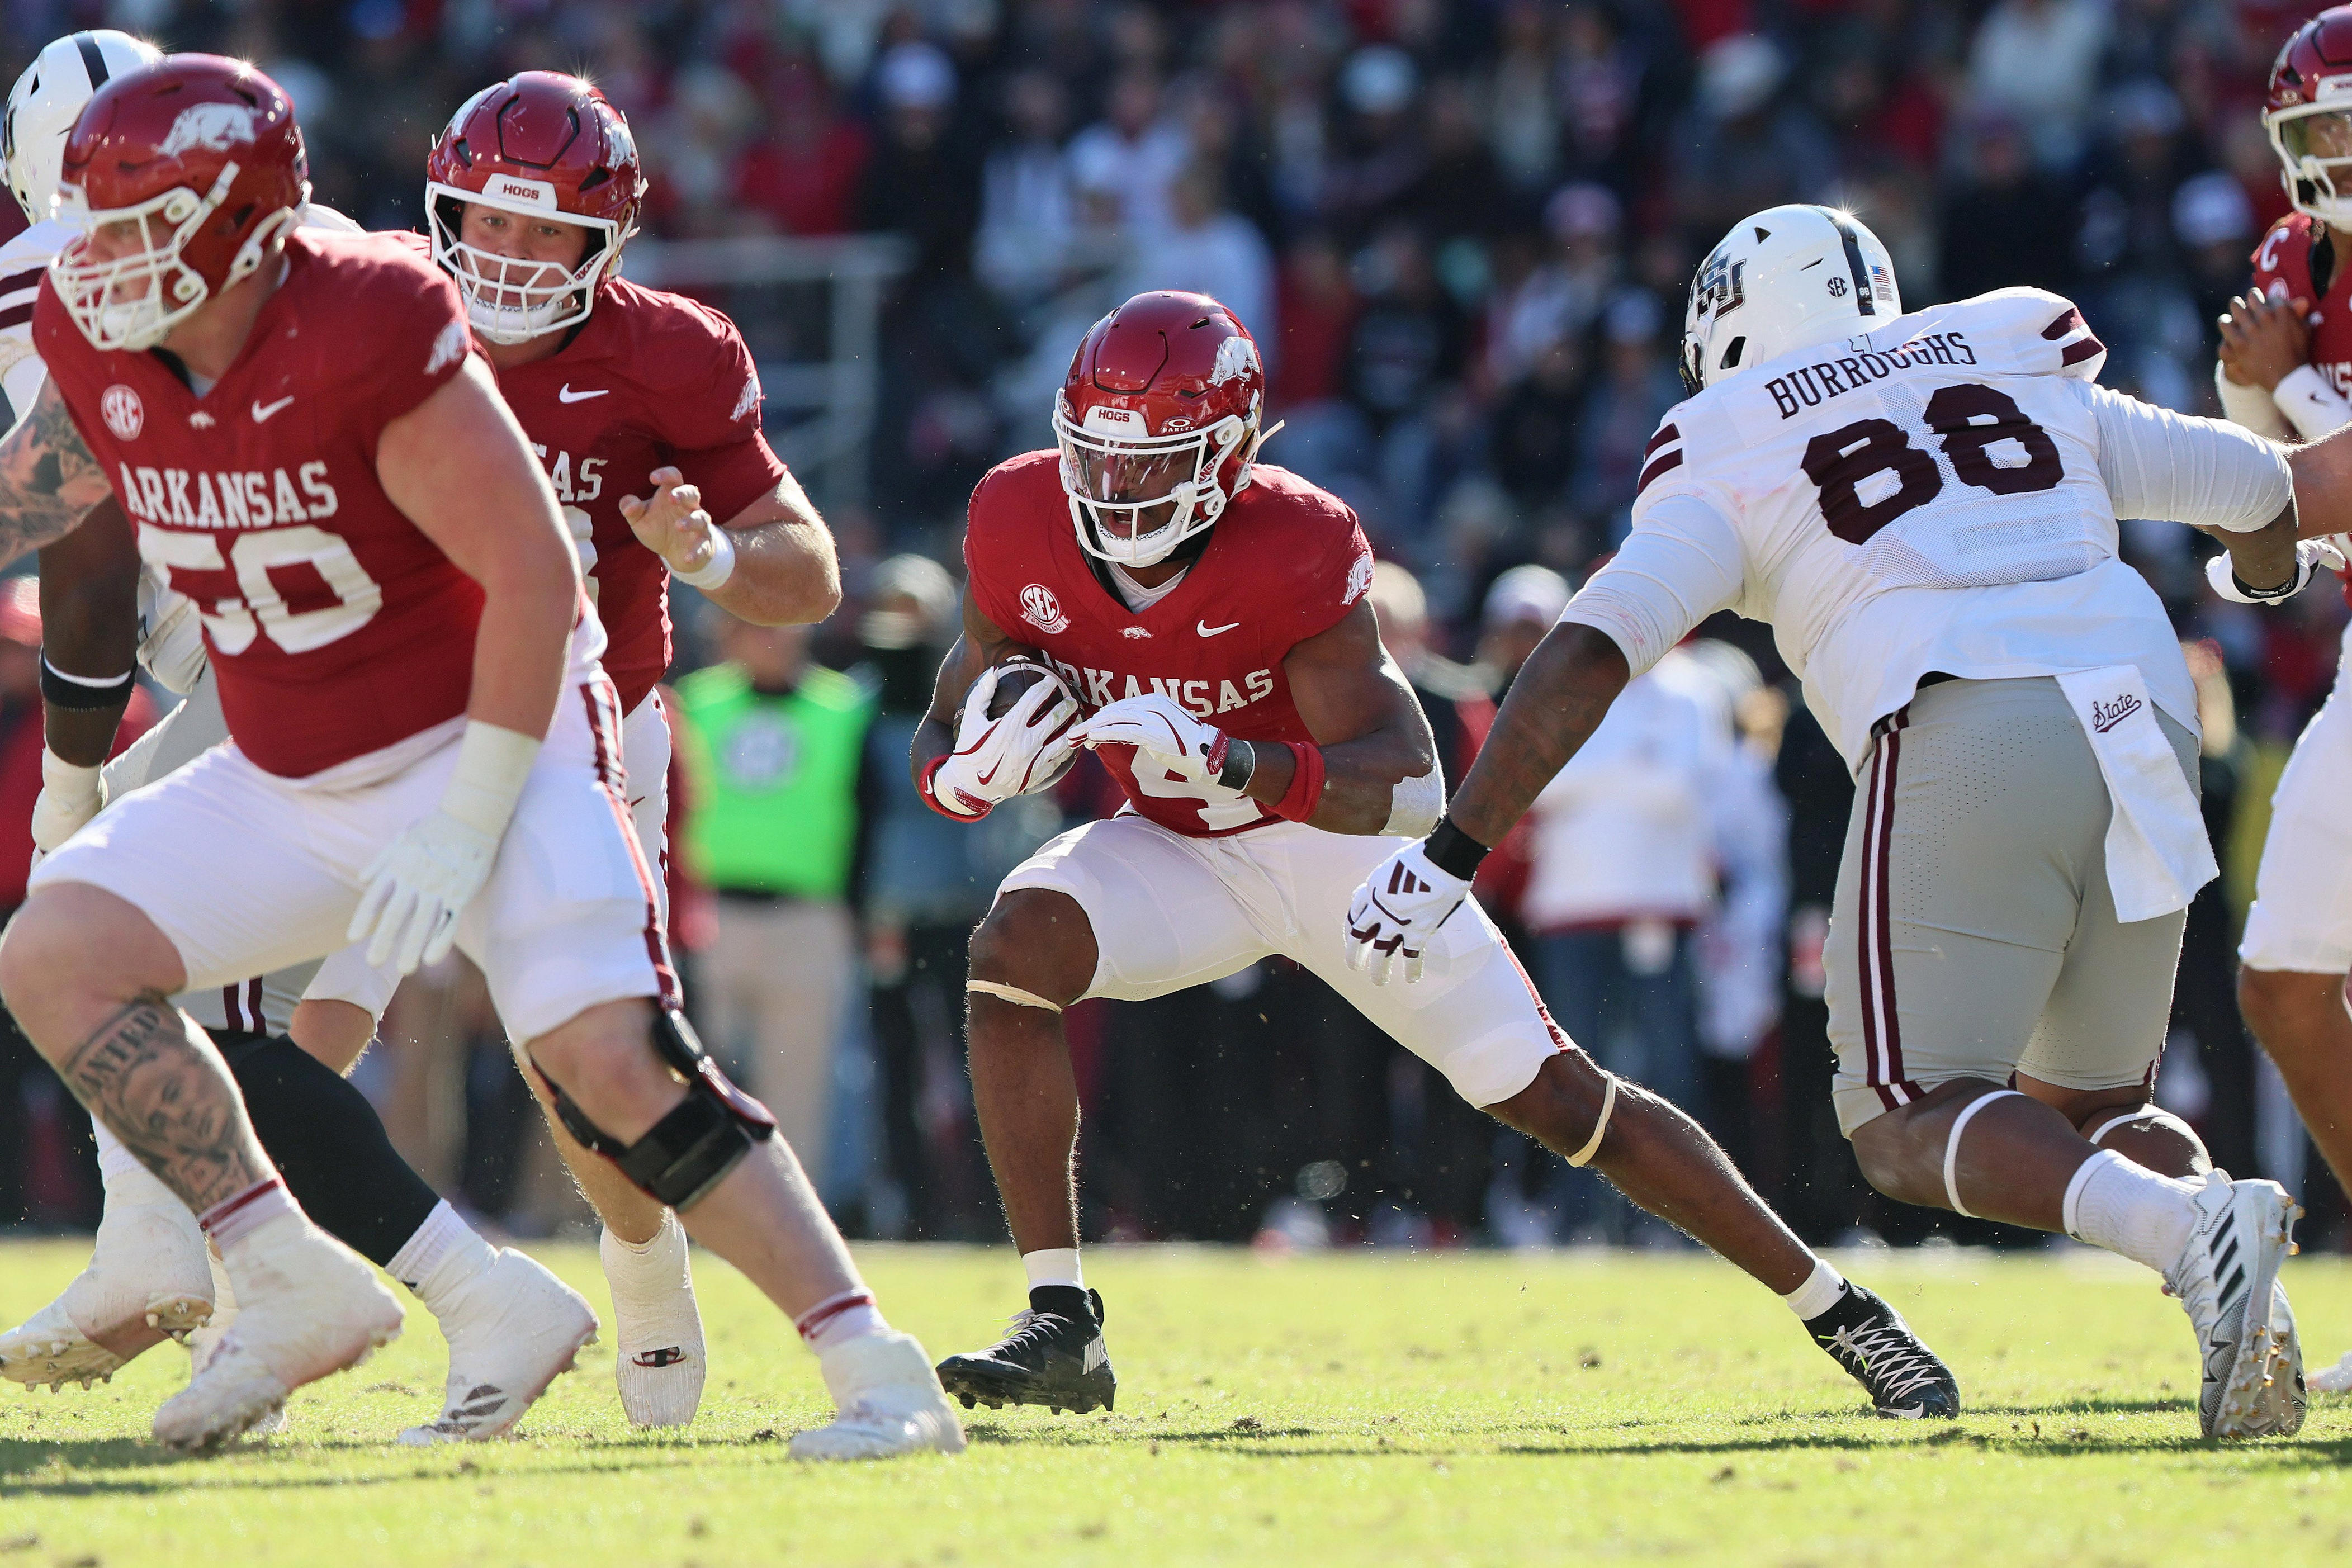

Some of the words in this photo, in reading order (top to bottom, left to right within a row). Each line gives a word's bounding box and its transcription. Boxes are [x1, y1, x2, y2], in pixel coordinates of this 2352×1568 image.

[503, 183, 539, 200] HOGS
[2260, 227, 2291, 272] C
[1827, 277, 1847, 297] SEC
[1859, 287, 1870, 296] 88
[1764, 332, 1977, 420] BURROUGHS
[105, 390, 140, 435] SEC
[1098, 409, 1130, 423] HOGS
[1800, 384, 2065, 545] 88
[119, 460, 338, 528] ARKANSAS
[138, 521, 382, 655] 50
[1023, 586, 1056, 620] SEC
[2093, 694, 2142, 733] State
[1082, 1334, 1108, 1376] NIK
